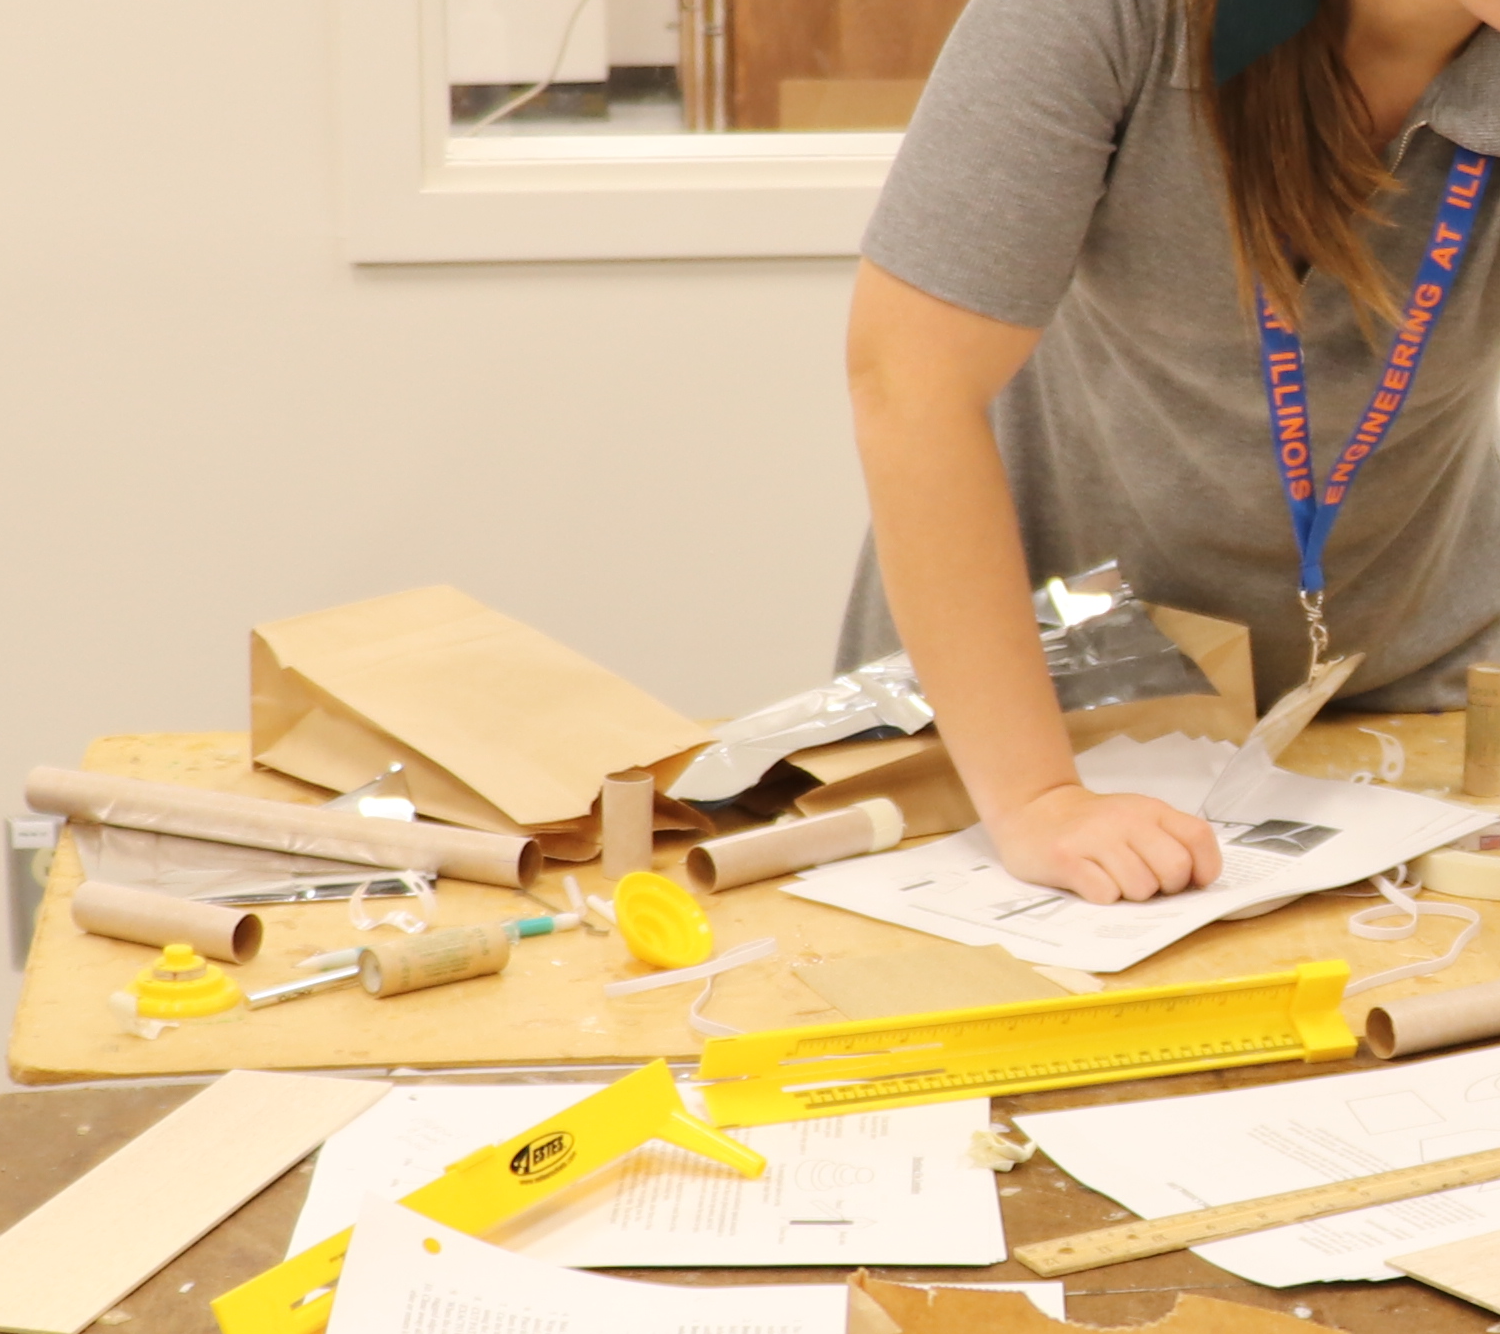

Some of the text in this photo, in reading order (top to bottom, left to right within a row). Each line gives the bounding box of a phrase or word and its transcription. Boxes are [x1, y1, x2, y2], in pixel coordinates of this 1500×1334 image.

[1268, 350, 1313, 501] ILLINOIS
[1322, 281, 1444, 507] ENGINEERING
[1430, 222, 1463, 272] AT
[533, 1135, 564, 1166] ESTES
